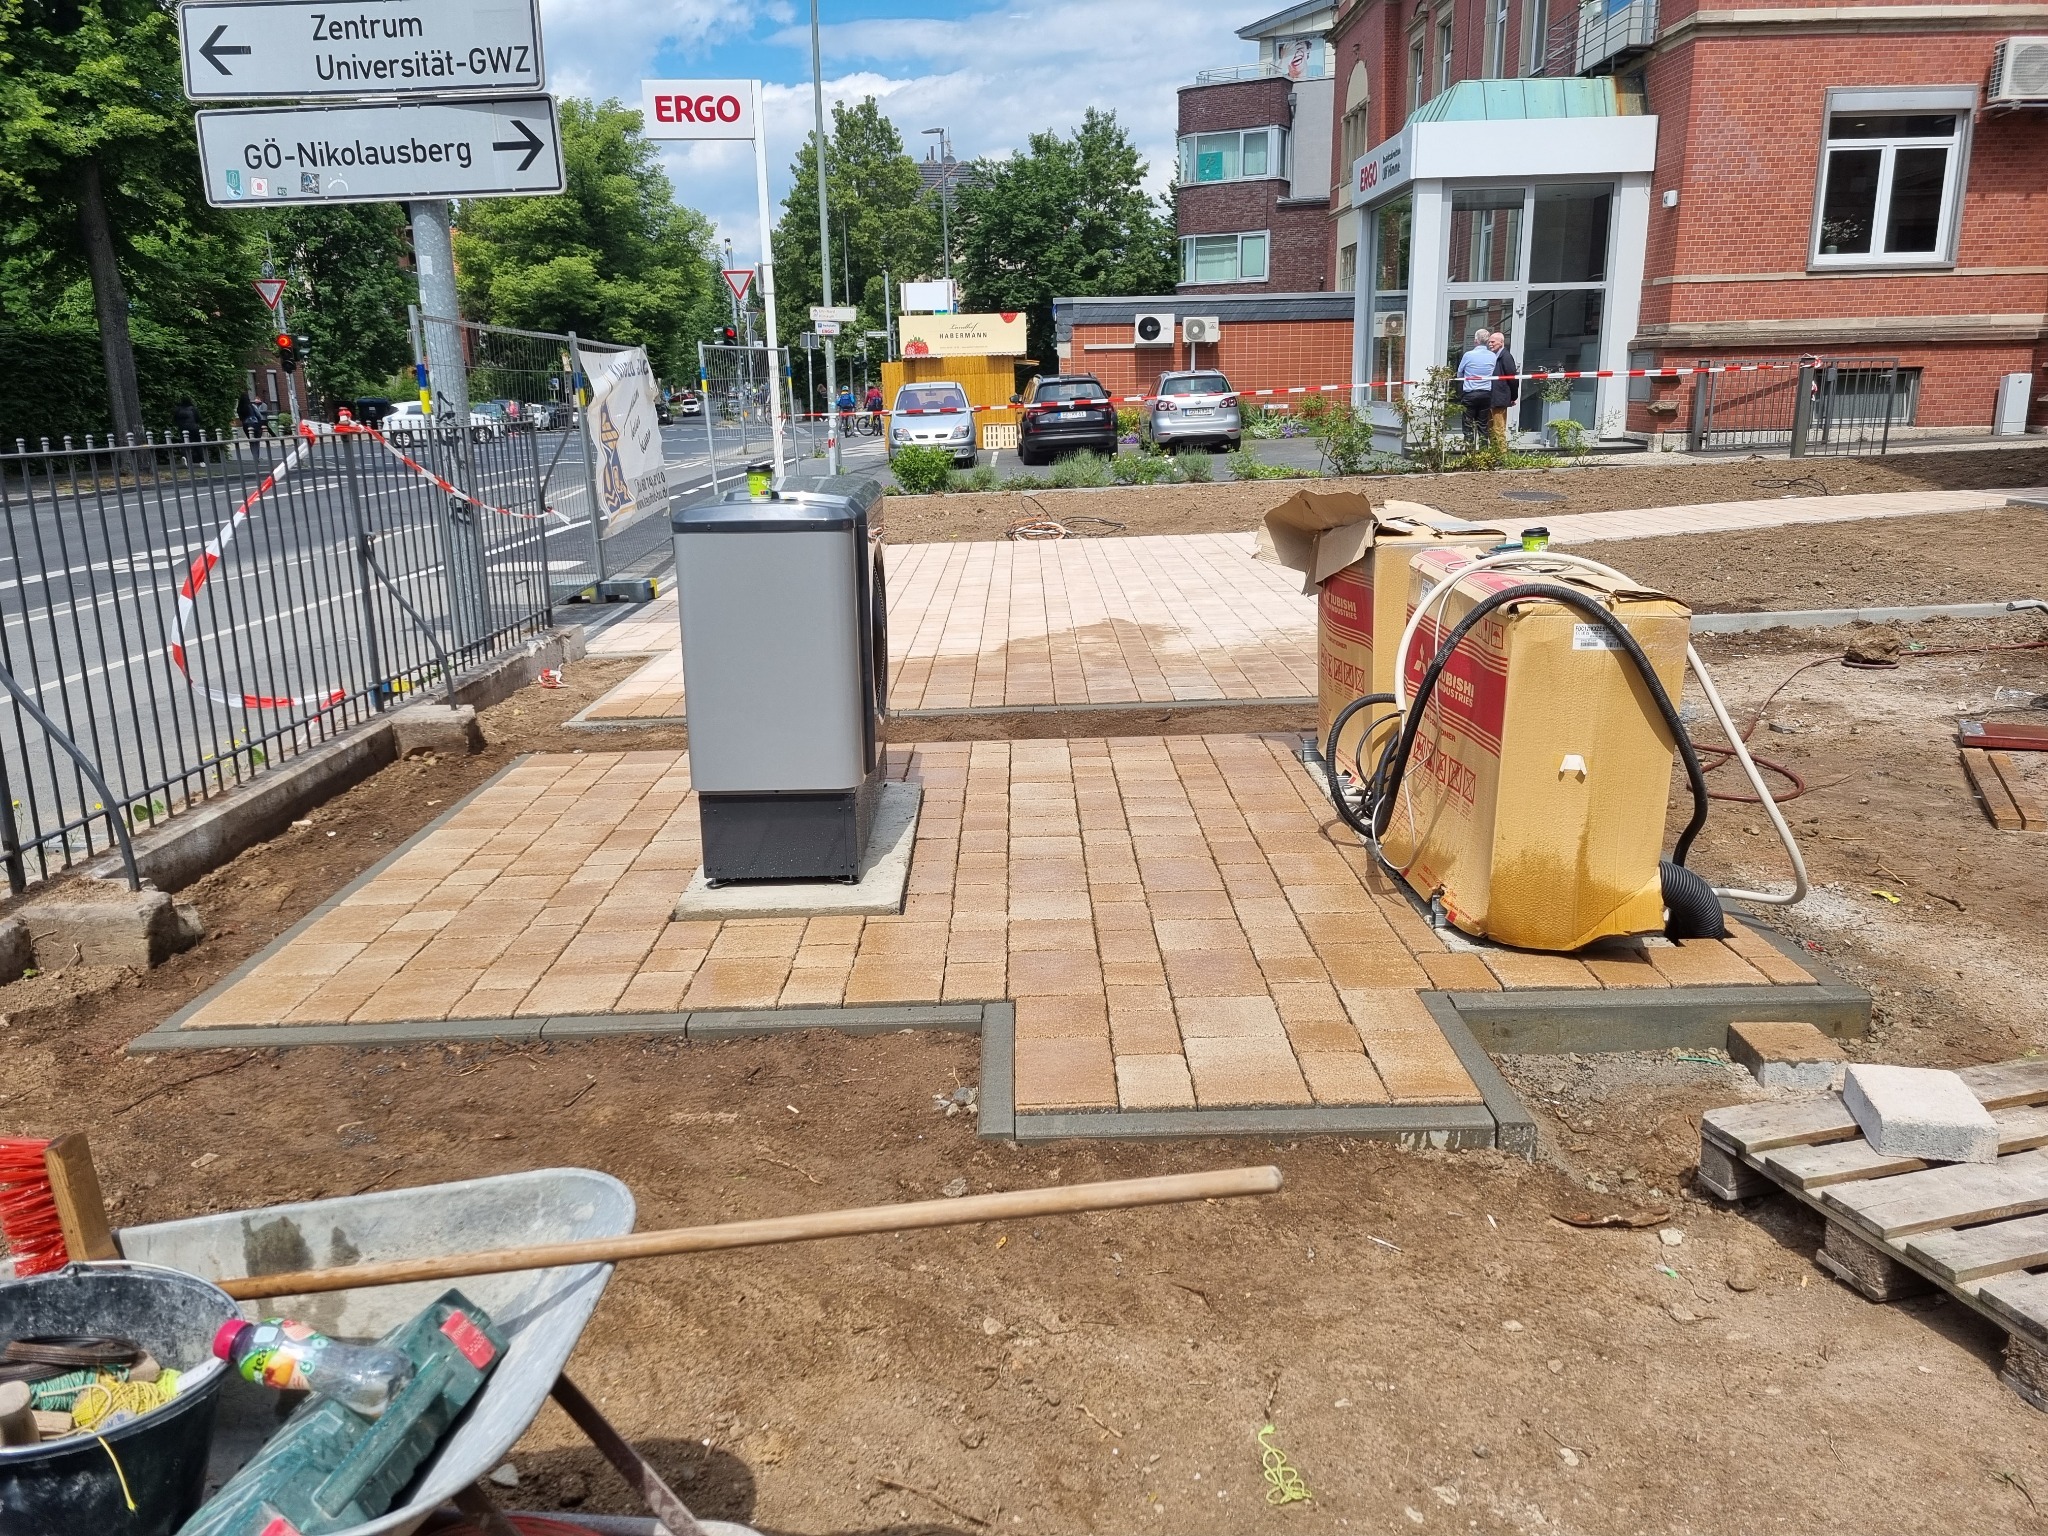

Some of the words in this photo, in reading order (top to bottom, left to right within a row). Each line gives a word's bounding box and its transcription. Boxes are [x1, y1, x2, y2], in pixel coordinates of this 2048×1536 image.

[310, 14, 423, 41] Zentrum
[315, 45, 531, 80] Universität-GWZ
[655, 95, 740, 123] ERGO
[244, 138, 472, 169] GÖ-Nikolausberg
[1360, 161, 1378, 192] ERGO
[1438, 668, 1475, 699] UBISHI
